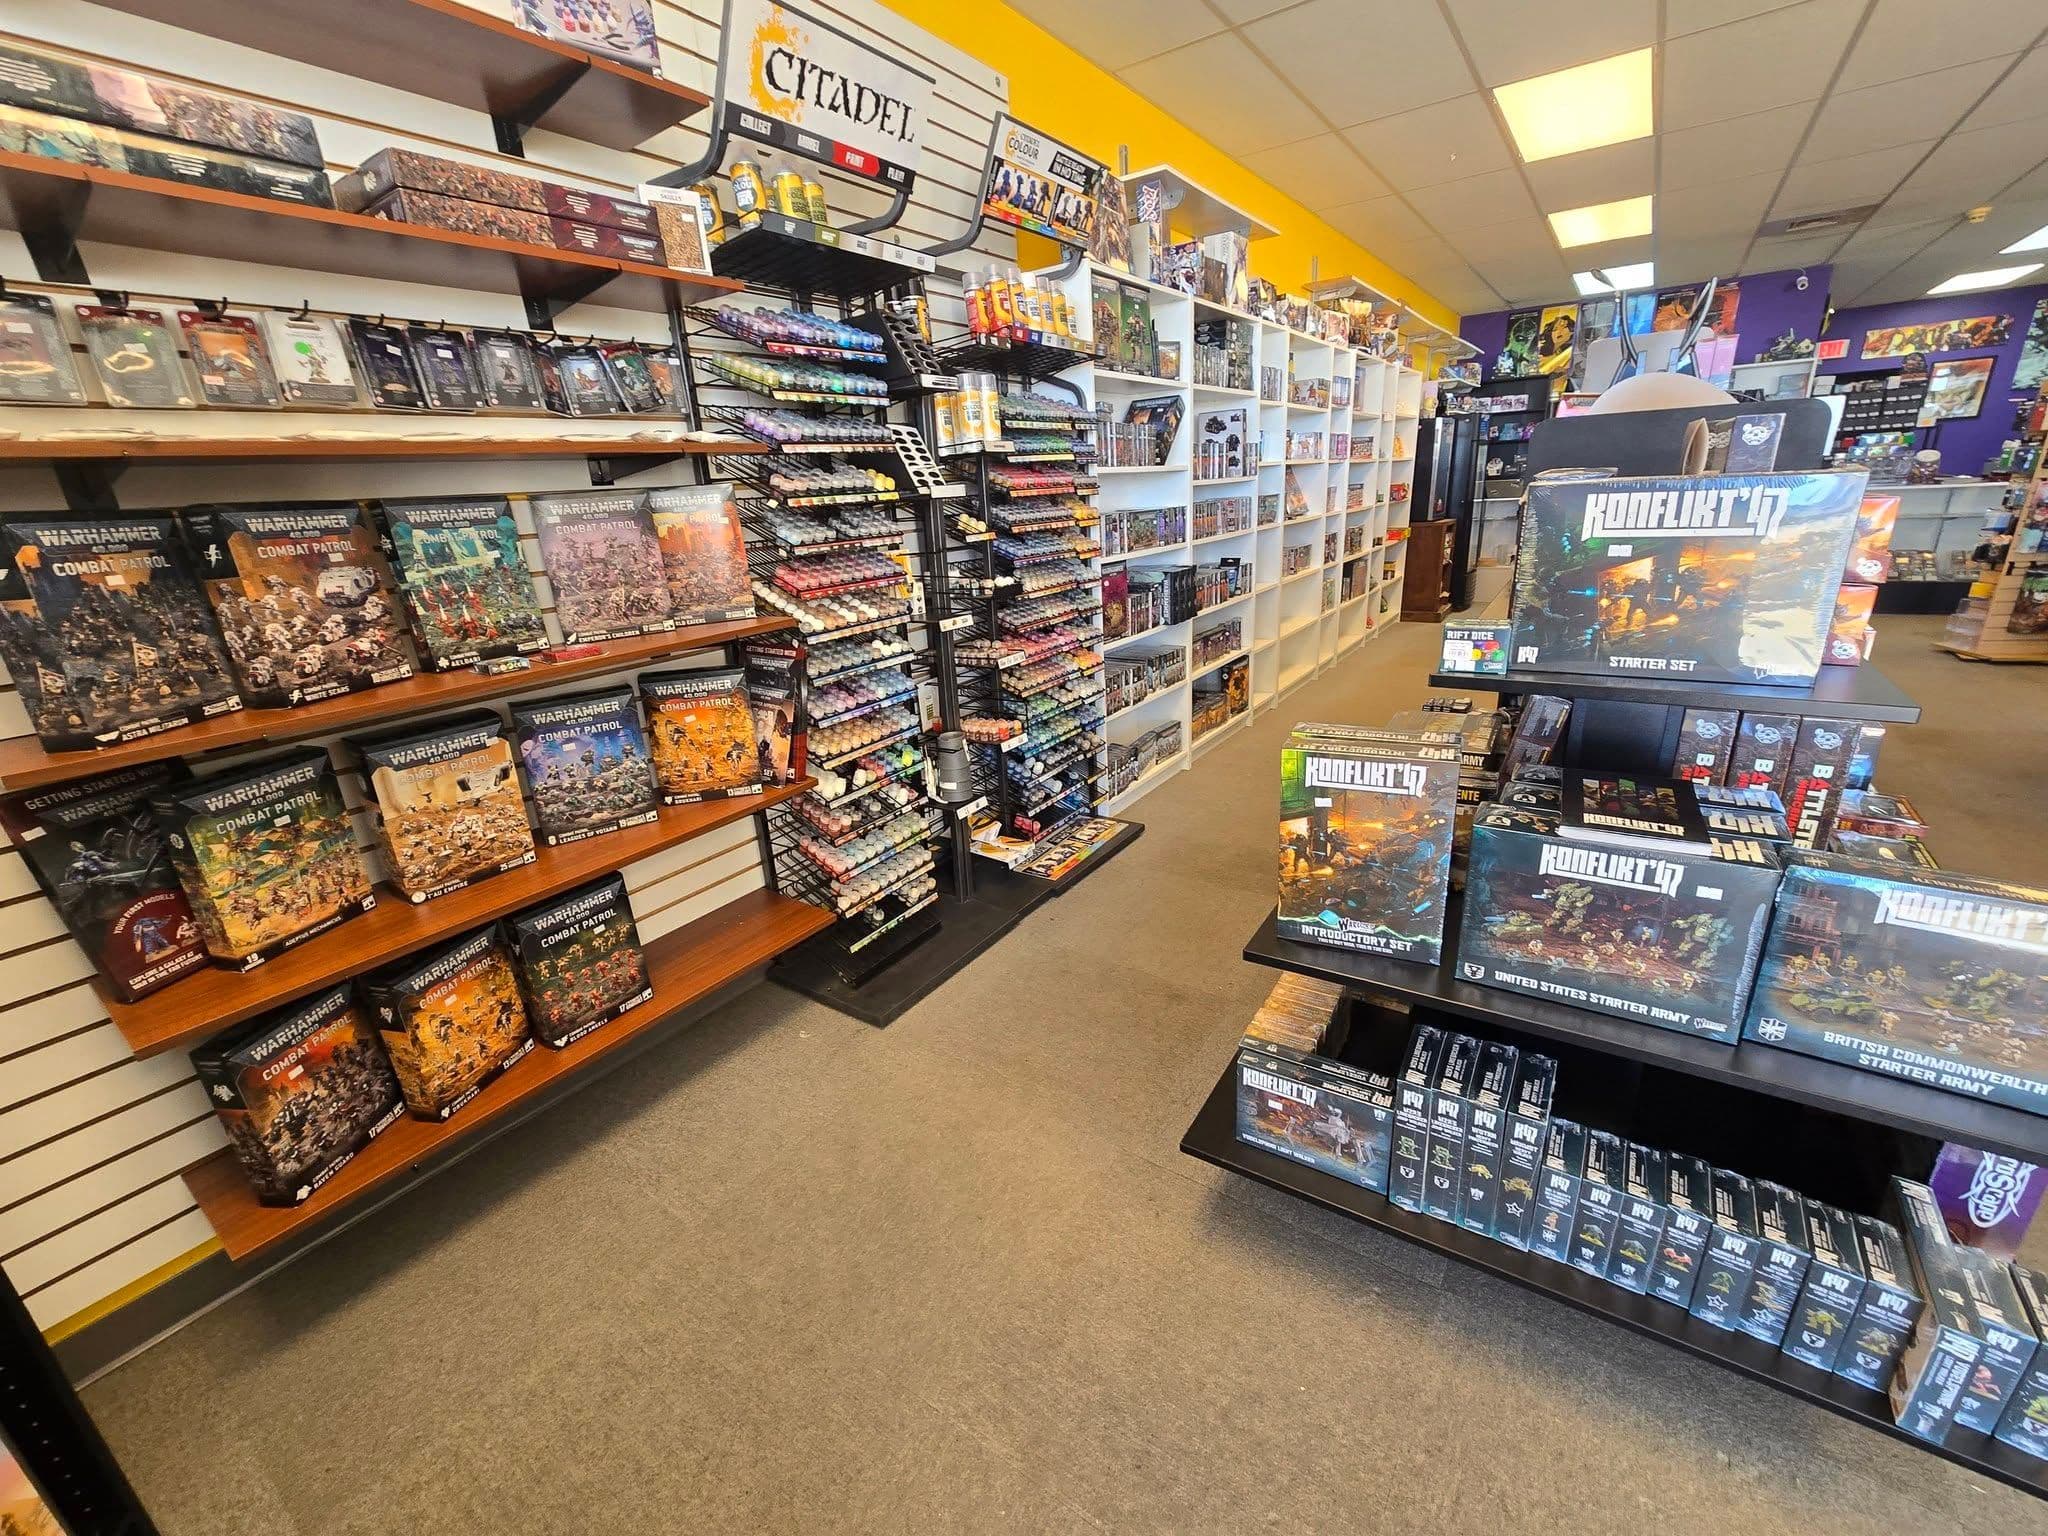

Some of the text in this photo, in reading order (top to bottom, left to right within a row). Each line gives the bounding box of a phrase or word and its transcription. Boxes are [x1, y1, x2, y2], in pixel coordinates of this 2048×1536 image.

[765, 46, 916, 143] CITADEL
[1008, 137, 1040, 160] COLOUR
[1061, 165, 1071, 179] NO
[405, 507, 498, 523] WARHAMMER
[549, 500, 635, 516] WARHAMMER
[1581, 485, 1790, 545] KONFLIKT'47
[36, 526, 162, 546] WARHAMMER
[245, 515, 349, 533] WARHAMMER
[556, 520, 638, 535] COMBAT PATROL
[257, 541, 358, 559] COMBAT PATROL
[52, 555, 171, 577] COMBAT PATROL
[1446, 630, 1495, 641] RIFT DICE
[451, 656, 481, 667] AELDARI
[1609, 655, 1697, 672] STARTER SET
[304, 686, 350, 702] WHITE SCARS
[655, 679, 732, 696] WARHAMMER
[532, 701, 621, 724] WARHAMMER
[659, 697, 735, 713] COMBAT PATROL
[122, 717, 189, 741] ASTRA MILITARUM
[538, 720, 623, 743] COMBAT PATROL
[389, 732, 489, 766] WARHAMMER
[399, 754, 492, 785] COMBAT PATROL
[1305, 756, 1428, 798] KONFLIKT'47
[24, 773, 137, 810] GETTING STARTED
[205, 766, 316, 811] WARHAMMER
[216, 791, 322, 834] COMBAT PATROL
[1793, 763, 1835, 849] BATTLETE
[559, 833, 587, 844] LEAGUES
[1583, 812, 1685, 837] KONFLIKT'47
[1538, 843, 1686, 899] KONFLIKT'47
[443, 880, 469, 894] EMPIRE
[113, 893, 175, 935] YOUR FIRST MODELS
[534, 890, 613, 930] WARHAMMER
[1873, 888, 2048, 955] KONFLIKT'
[541, 908, 617, 948] COMBAT PATROL
[1301, 924, 1413, 952] INTRODUCTORY SET
[246, 953, 259, 964] 19
[411, 936, 489, 991] WARHAMMER
[129, 966, 159, 985] EXPLORE
[419, 957, 497, 1009] COMBAT PATROL
[1494, 970, 1690, 1025] UNITED STATES STARTER ARMY
[250, 993, 346, 1061] WARHAMMER
[262, 1015, 352, 1081] COMBAT PATROL
[1823, 1031, 2048, 1097] BRITISH COMMONWEALTH
[1858, 1053, 1995, 1096] STARTER ARMY
[1242, 1067, 1317, 1108] KONFLIKT'47
[313, 1152, 354, 1190] RAVEN GUARD
